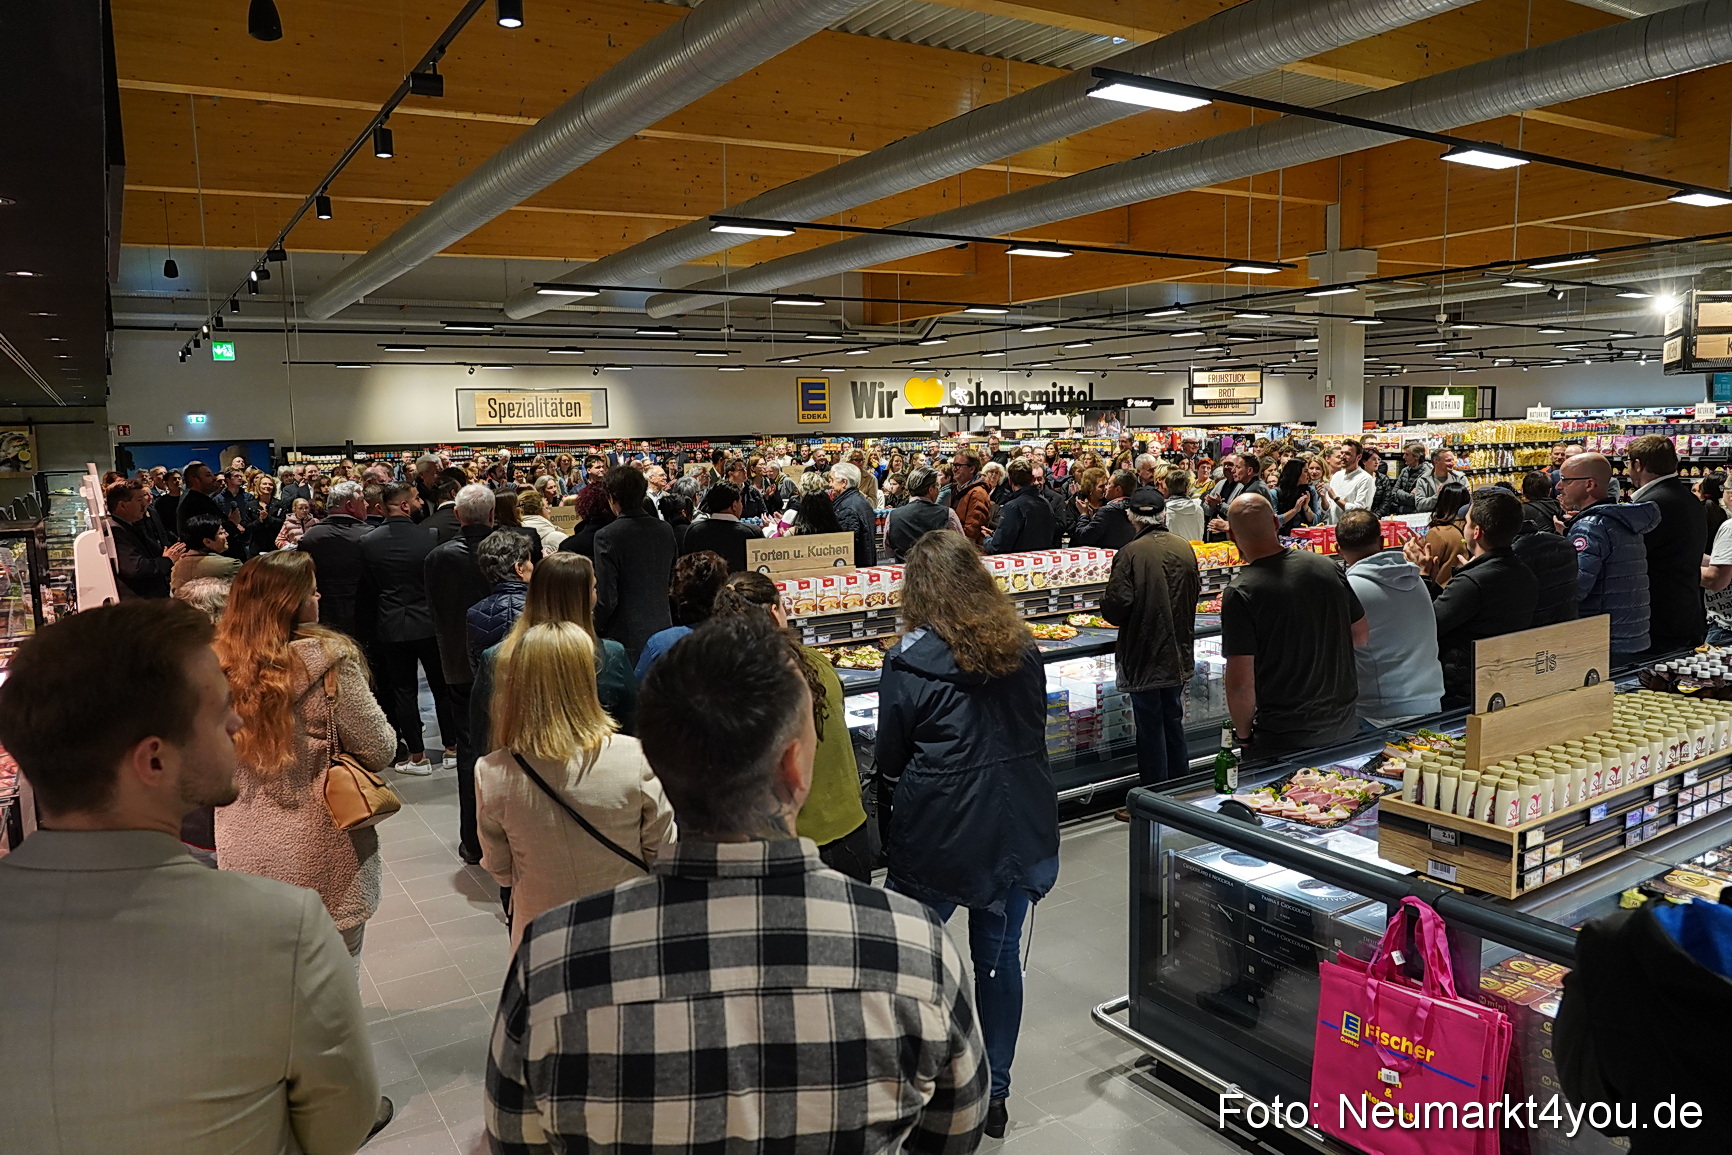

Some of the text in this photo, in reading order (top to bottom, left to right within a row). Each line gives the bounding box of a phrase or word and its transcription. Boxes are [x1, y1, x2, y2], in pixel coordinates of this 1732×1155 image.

[850, 381, 898, 419] Wir
[1218, 387, 1236, 398] BROT
[487, 395, 582, 424] Spezialitäten
[1430, 400, 1461, 410] NATURKIND
[550, 513, 579, 523] ommes
[752, 544, 849, 562] Torten u. Kuchen
[1535, 650, 1557, 674] Eis
[1261, 895, 1277, 905] PANNA
[1280, 901, 1311, 917] CIOCCOLATO
[1340, 1035, 1360, 1049] Center
[1365, 1023, 1435, 1063] Fischer
[1384, 1088, 1393, 1098] &
